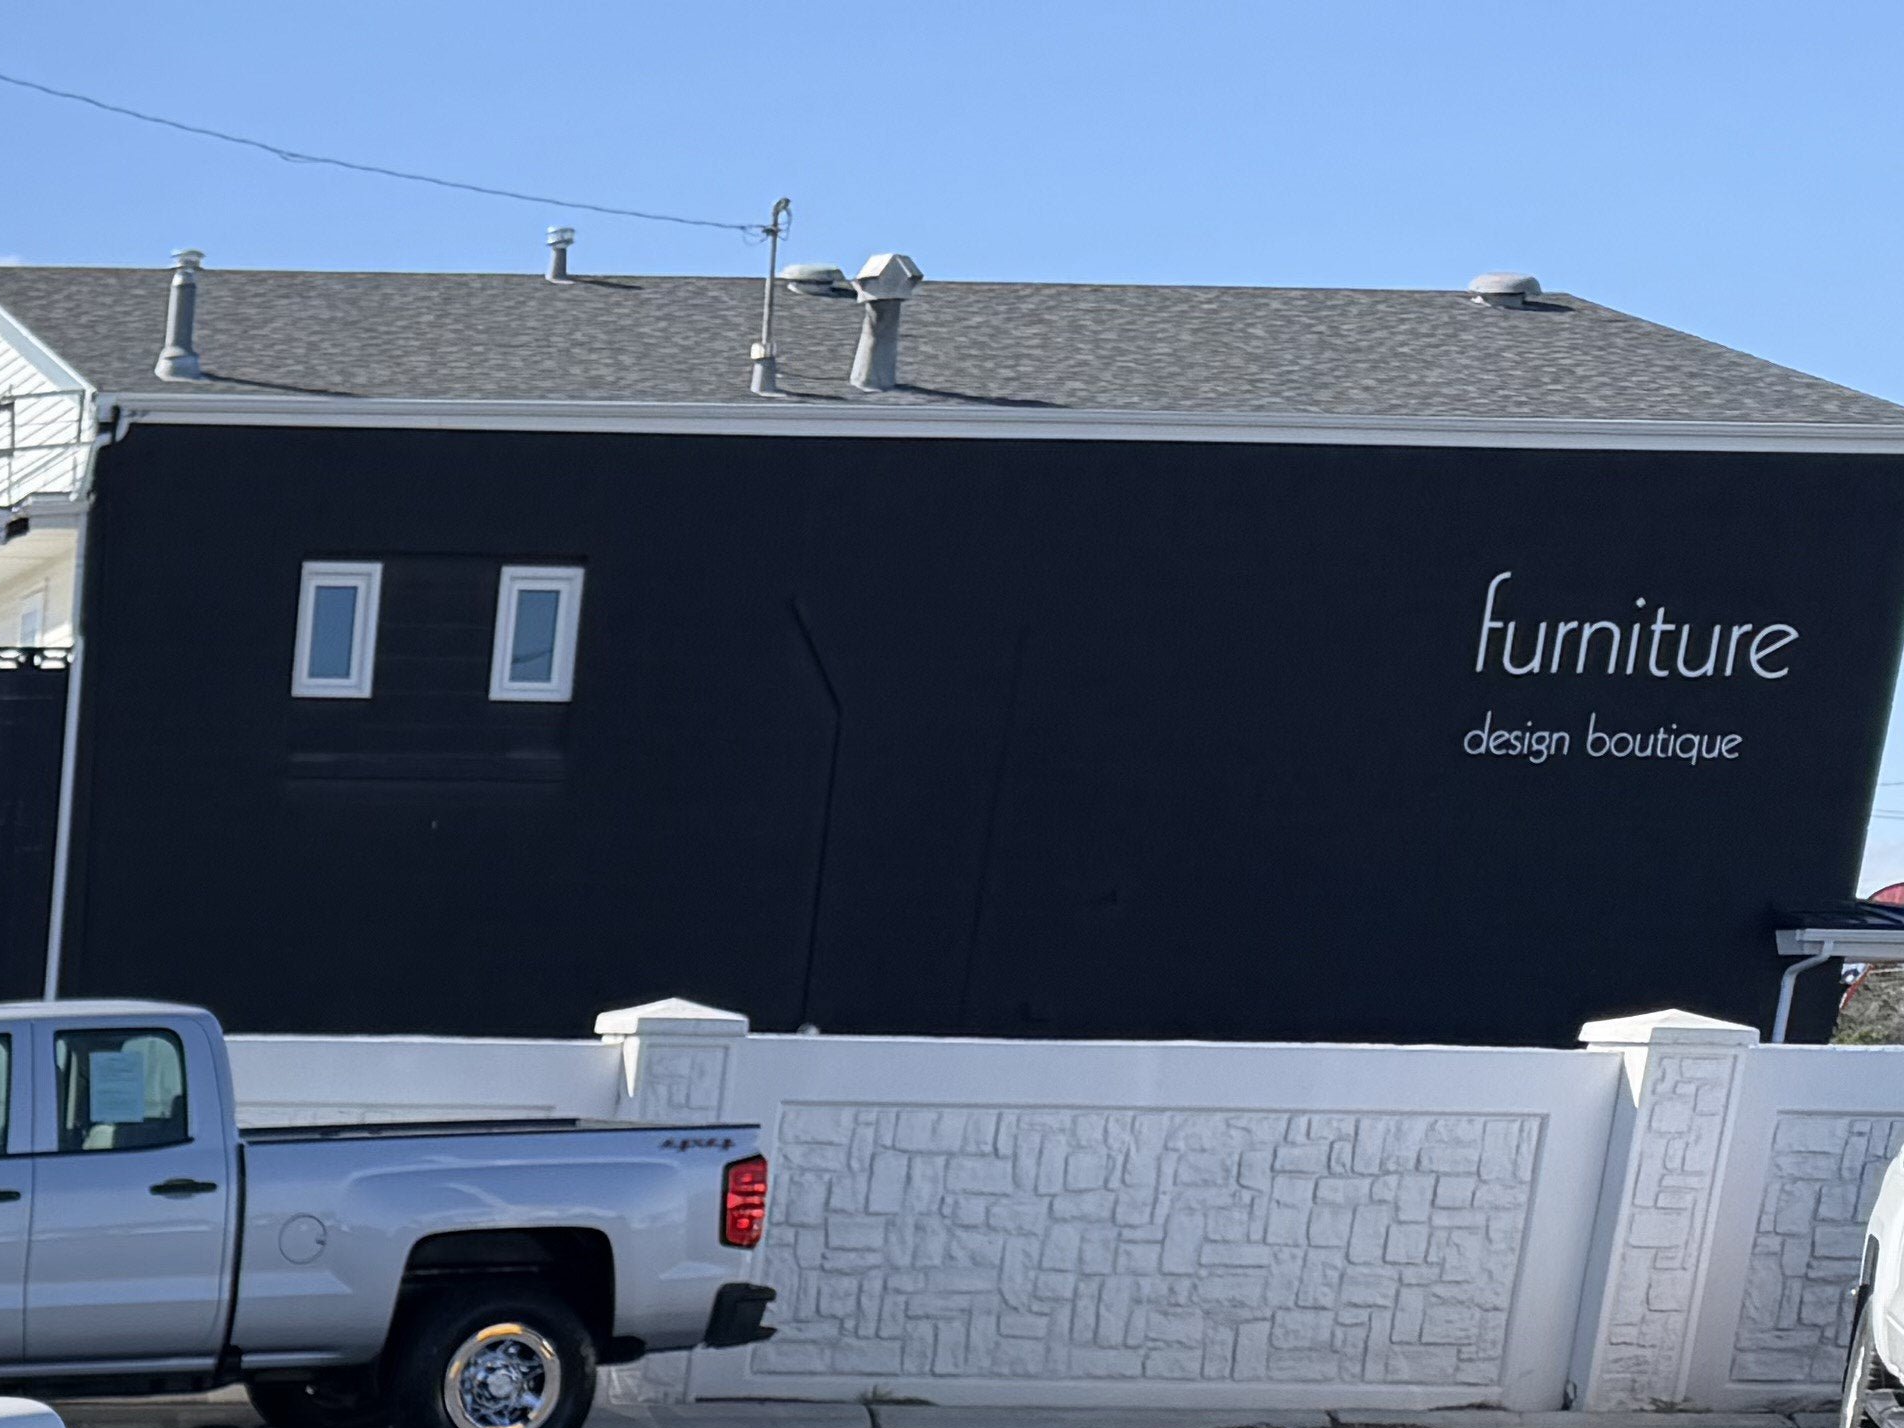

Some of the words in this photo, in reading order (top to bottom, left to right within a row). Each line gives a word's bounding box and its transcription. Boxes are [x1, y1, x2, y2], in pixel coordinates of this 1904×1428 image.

[1475, 571, 1799, 679] furniture
[1463, 711, 1570, 763] design
[1586, 712, 1743, 766] boutique
